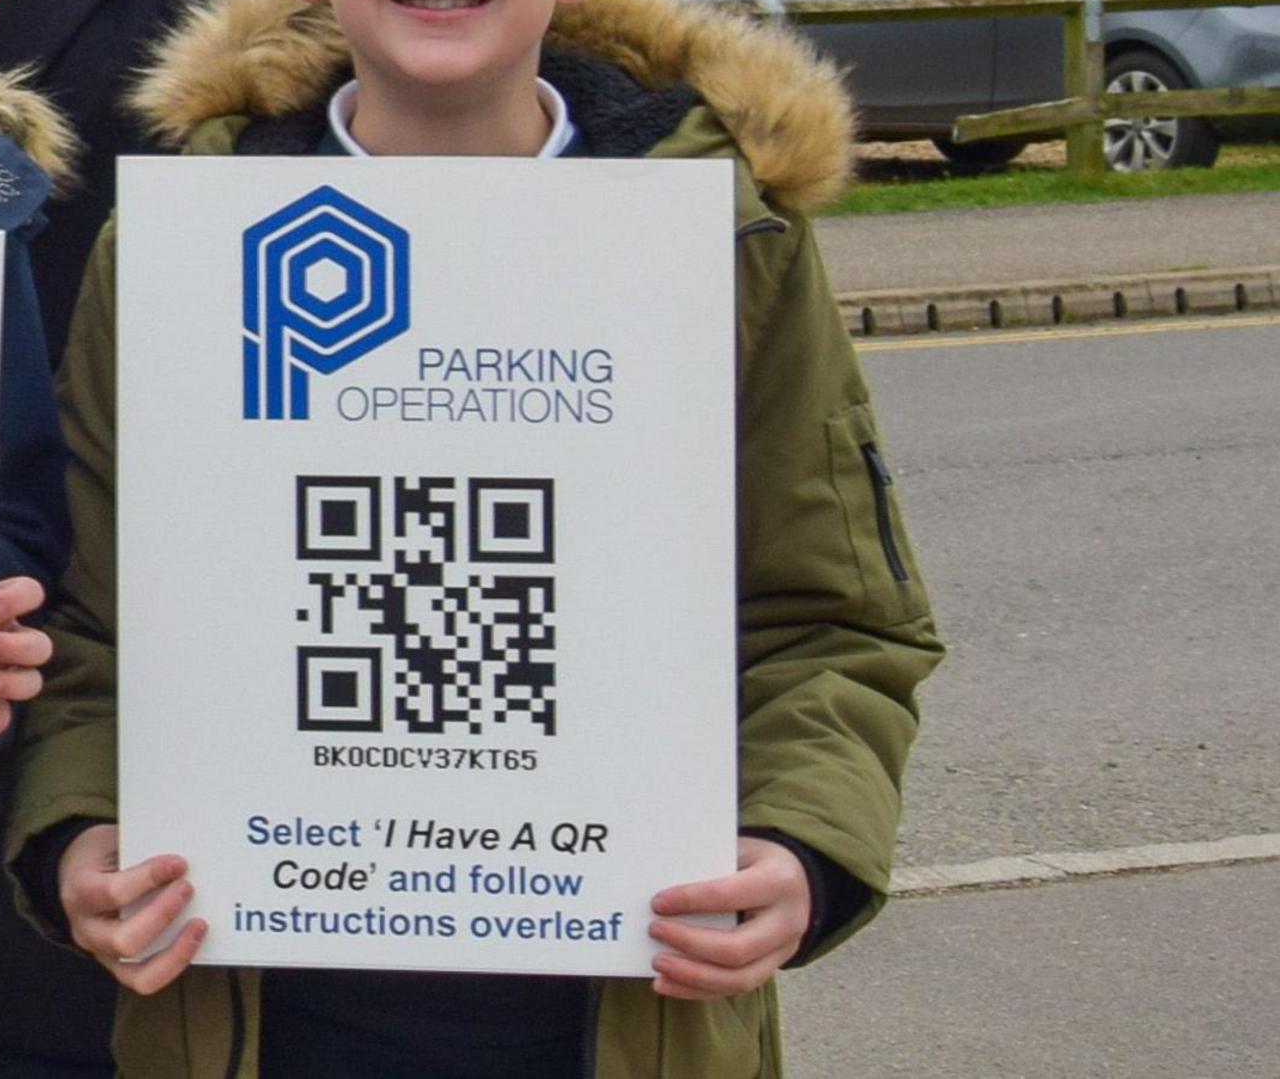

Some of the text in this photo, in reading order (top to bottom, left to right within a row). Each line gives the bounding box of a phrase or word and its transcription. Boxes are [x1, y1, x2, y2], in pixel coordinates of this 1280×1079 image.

[419, 347, 614, 385] PARKING
[336, 385, 614, 425] OPERATIONS
[246, 815, 362, 850] Select
[406, 819, 501, 852] Have
[509, 821, 538, 852] A
[549, 822, 609, 856] QR
[271, 859, 584, 898] Code’ and follow
[234, 903, 622, 943] instructions overleaf
